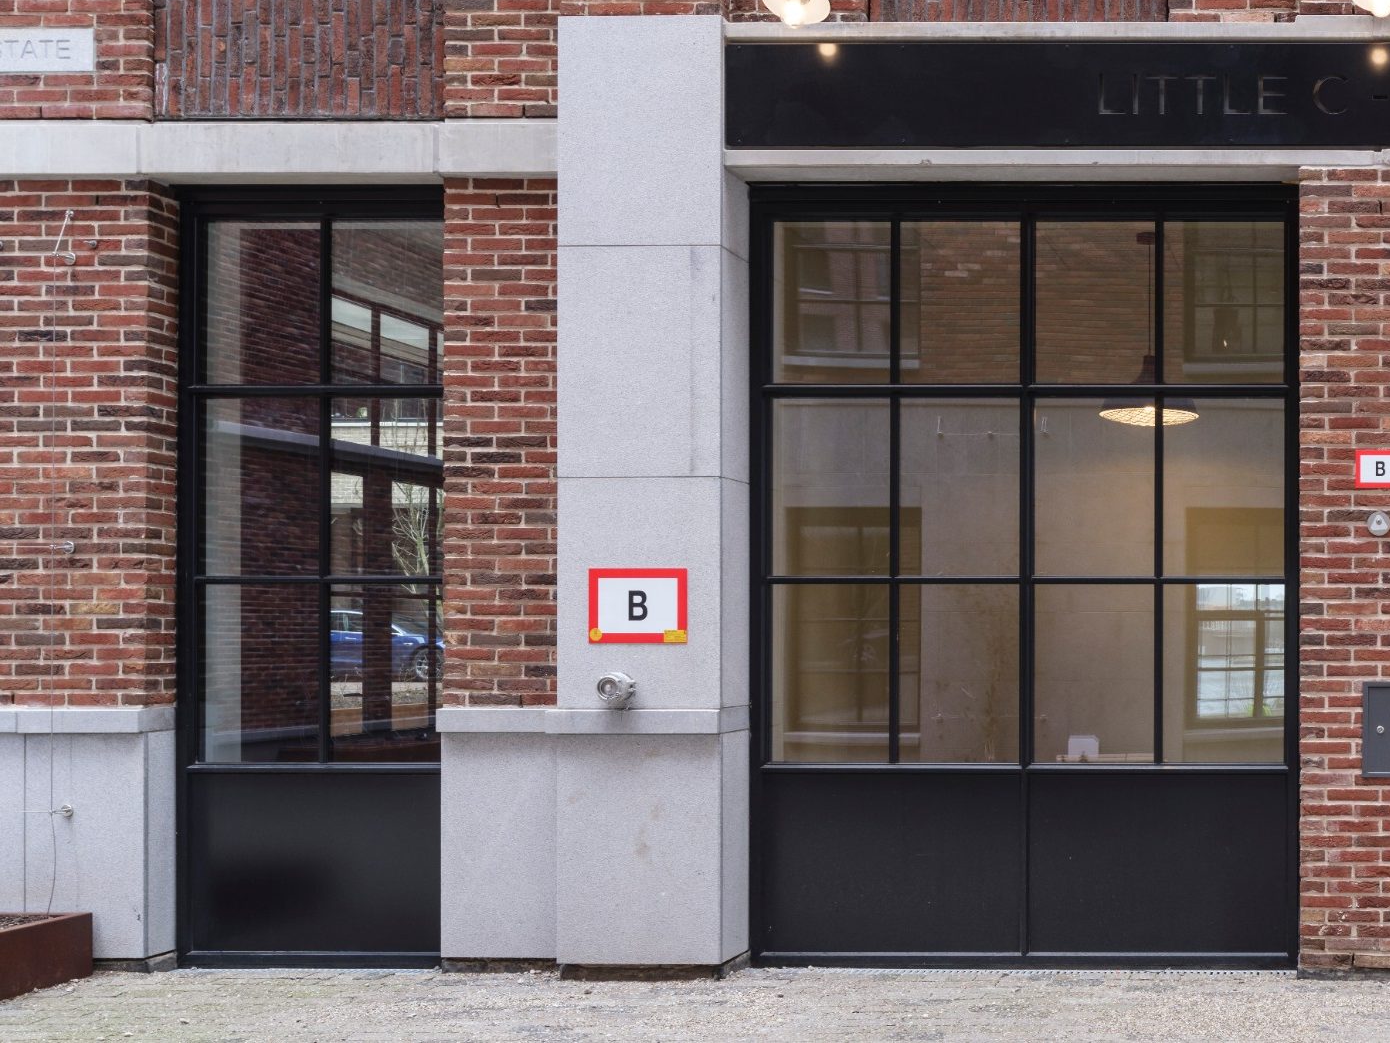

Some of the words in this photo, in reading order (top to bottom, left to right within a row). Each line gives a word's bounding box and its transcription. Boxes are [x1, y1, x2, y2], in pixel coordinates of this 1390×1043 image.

[0, 39, 71, 60] TATE
[1097, 73, 1289, 115] LITTLE
[1312, 74, 1349, 115] C
[1375, 460, 1386, 477] B
[628, 590, 648, 621] B
